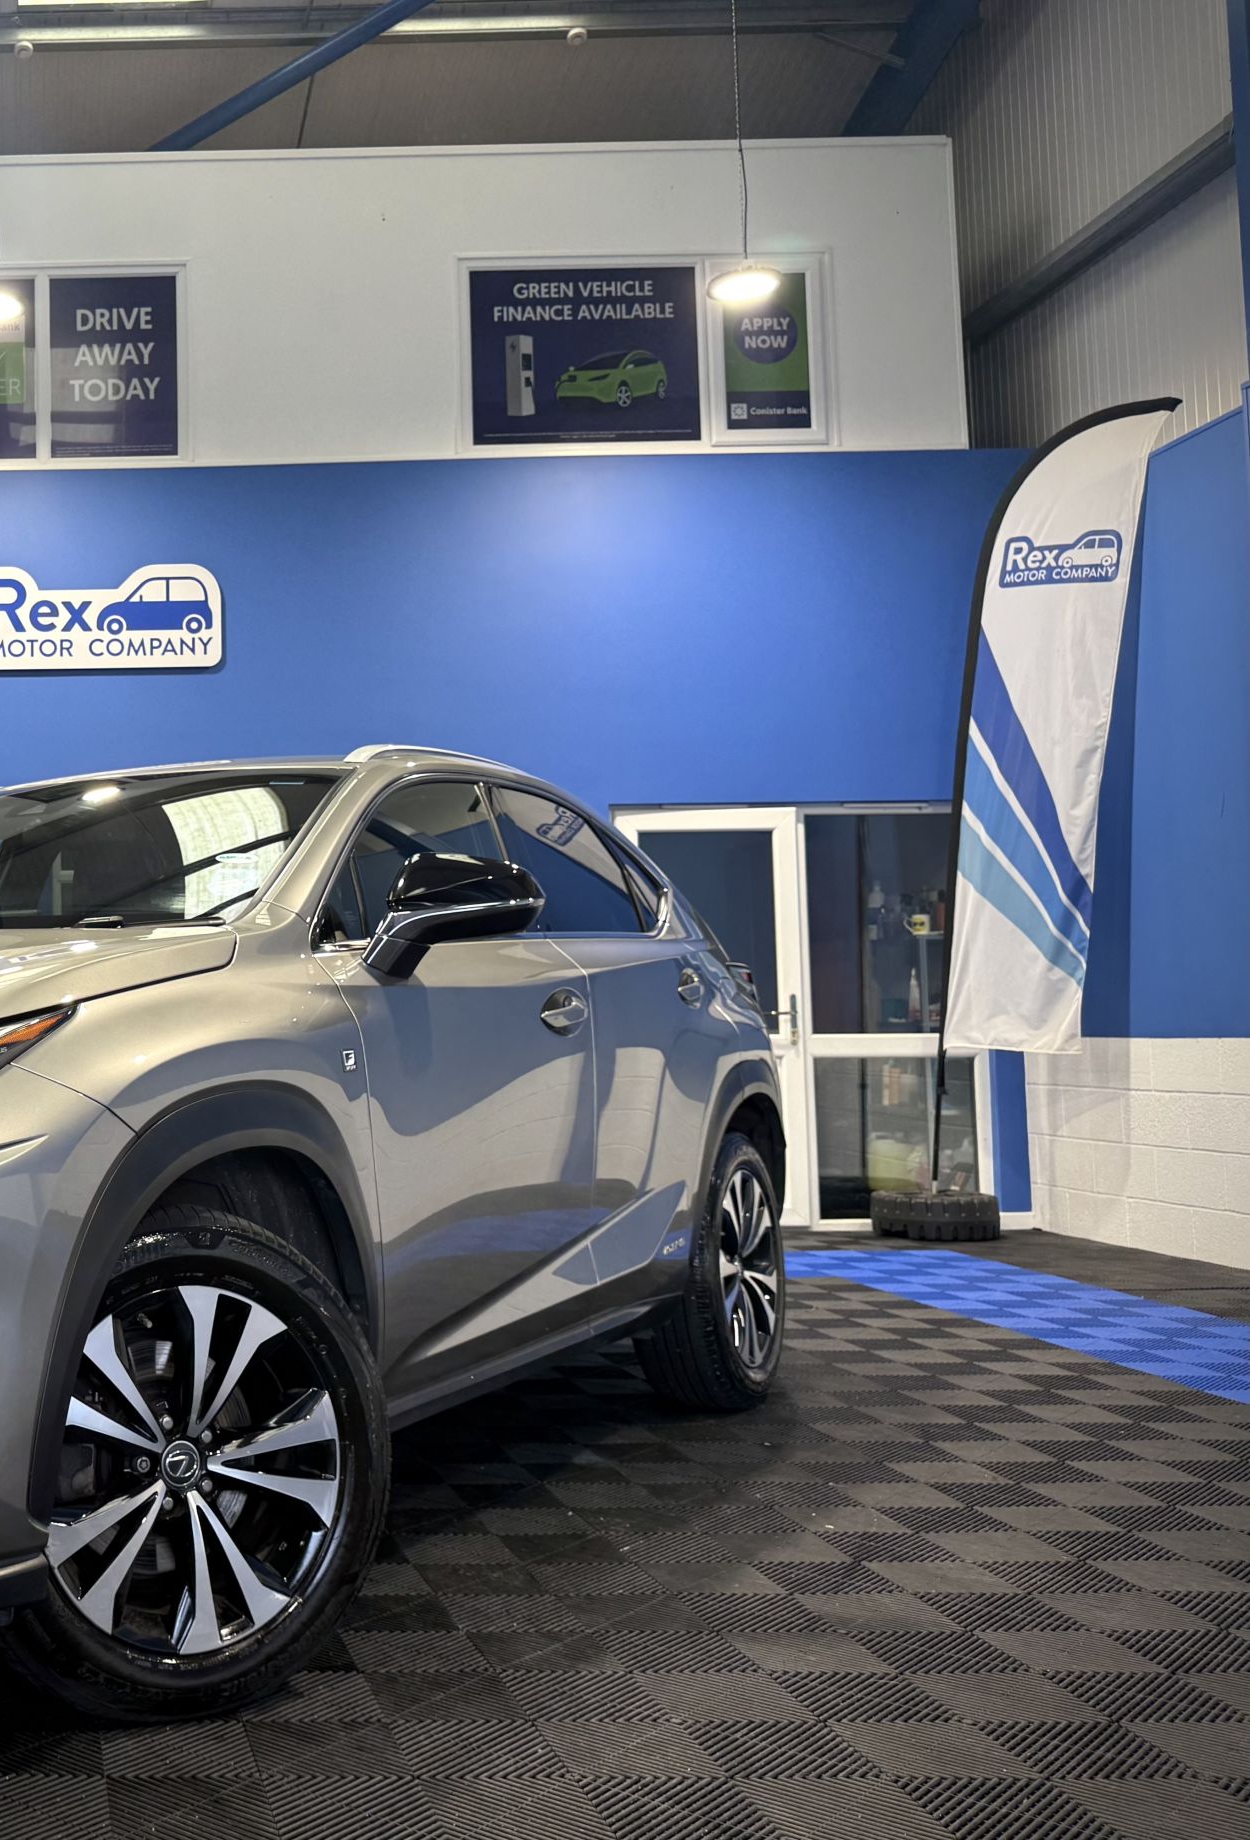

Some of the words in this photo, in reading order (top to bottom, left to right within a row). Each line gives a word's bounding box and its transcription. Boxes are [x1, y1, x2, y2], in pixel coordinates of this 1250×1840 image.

[513, 282, 573, 299] GREEN
[578, 280, 654, 297] VEHICLE
[76, 307, 153, 331] DRIVE
[493, 305, 573, 322] FINANCE
[577, 302, 675, 320] AVAILABLE
[741, 316, 790, 331] APPLY
[744, 335, 788, 349] NOW
[74, 342, 155, 367] AWAY
[69, 377, 161, 402] TODAY
[750, 406, 785, 415] Conister
[786, 406, 808, 415] Bank
[1006, 541, 1058, 571] Rex
[1004, 570, 1047, 583] MOTOR
[1052, 566, 1116, 580] COMPANY
[88, 636, 213, 657] COMPANY
